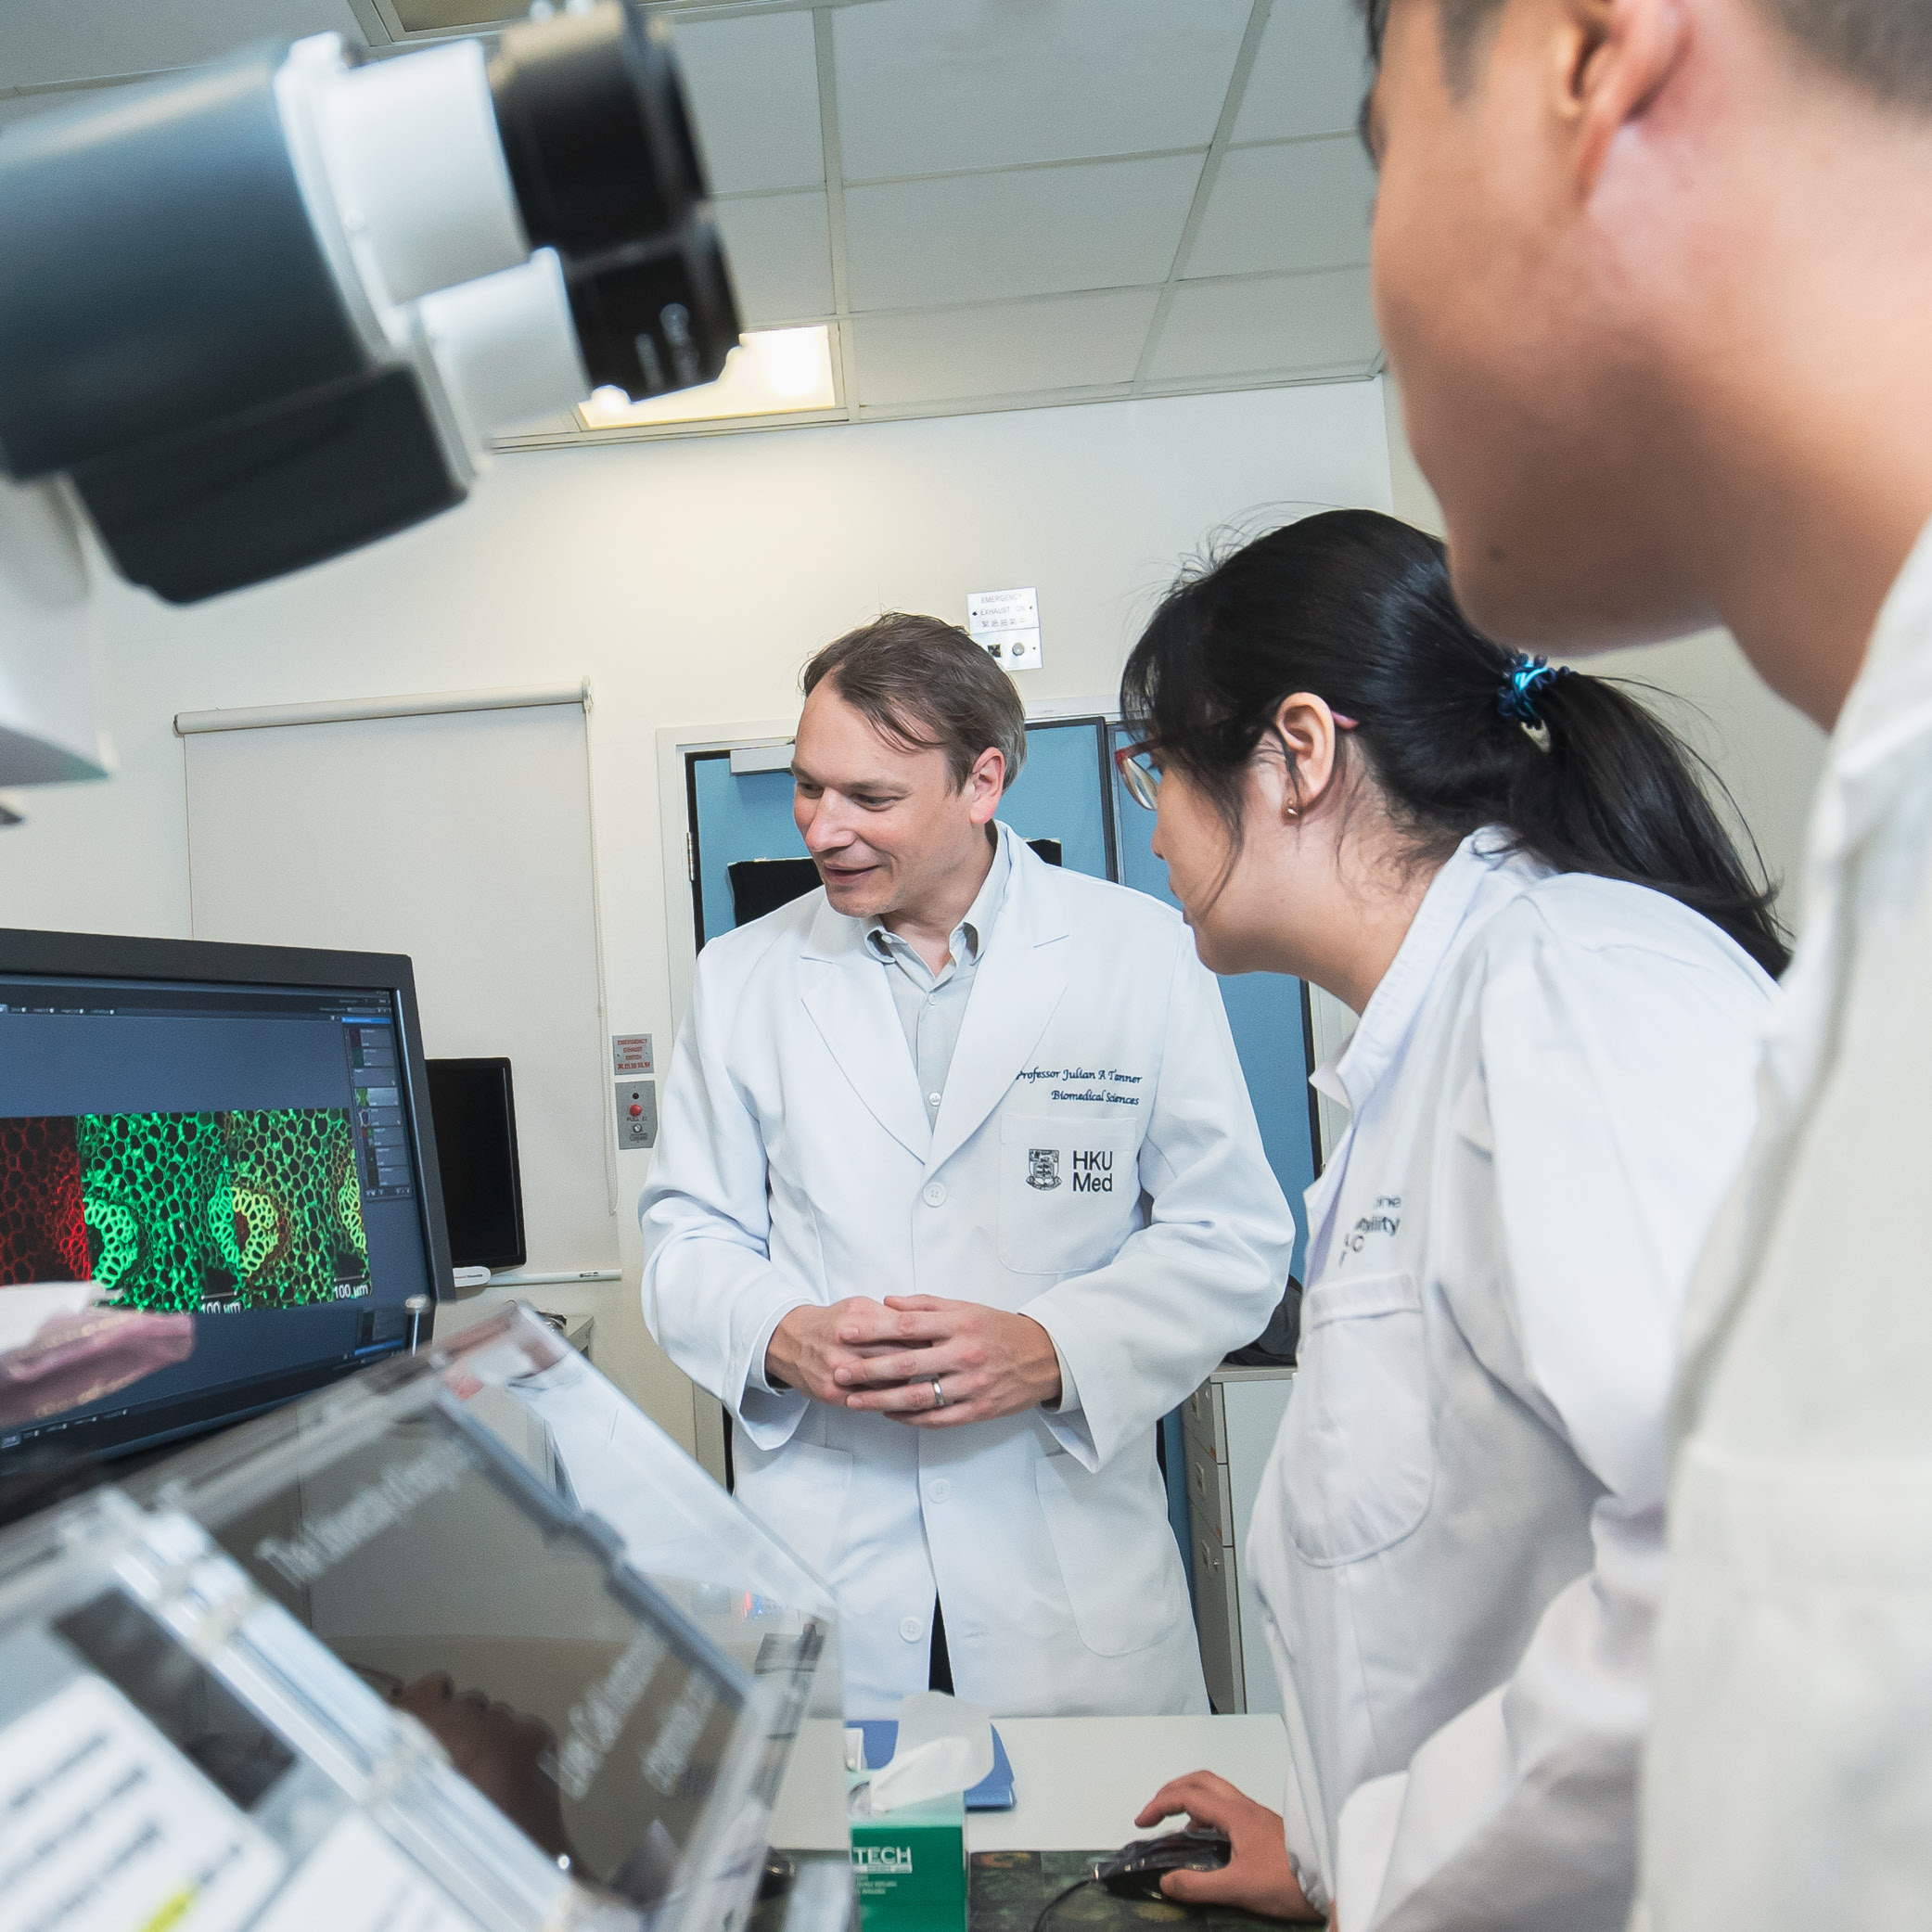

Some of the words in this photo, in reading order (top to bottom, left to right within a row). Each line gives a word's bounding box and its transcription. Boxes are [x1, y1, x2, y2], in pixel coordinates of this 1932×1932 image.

[981, 594, 1021, 604] EMERGENCY
[980, 607, 1010, 616] EXHAUST
[1062, 1068, 1096, 1081] Julian
[1098, 1070, 1107, 1080] A
[1108, 1069, 1143, 1083] Tanner
[1051, 1089, 1105, 1101] Biomedical
[1106, 1090, 1140, 1105] Sciences
[1072, 1150, 1113, 1171] HKU
[1072, 1172, 1113, 1192] Med
[334, 1285, 351, 1299] 100
[853, 1847, 912, 1865] TECH
